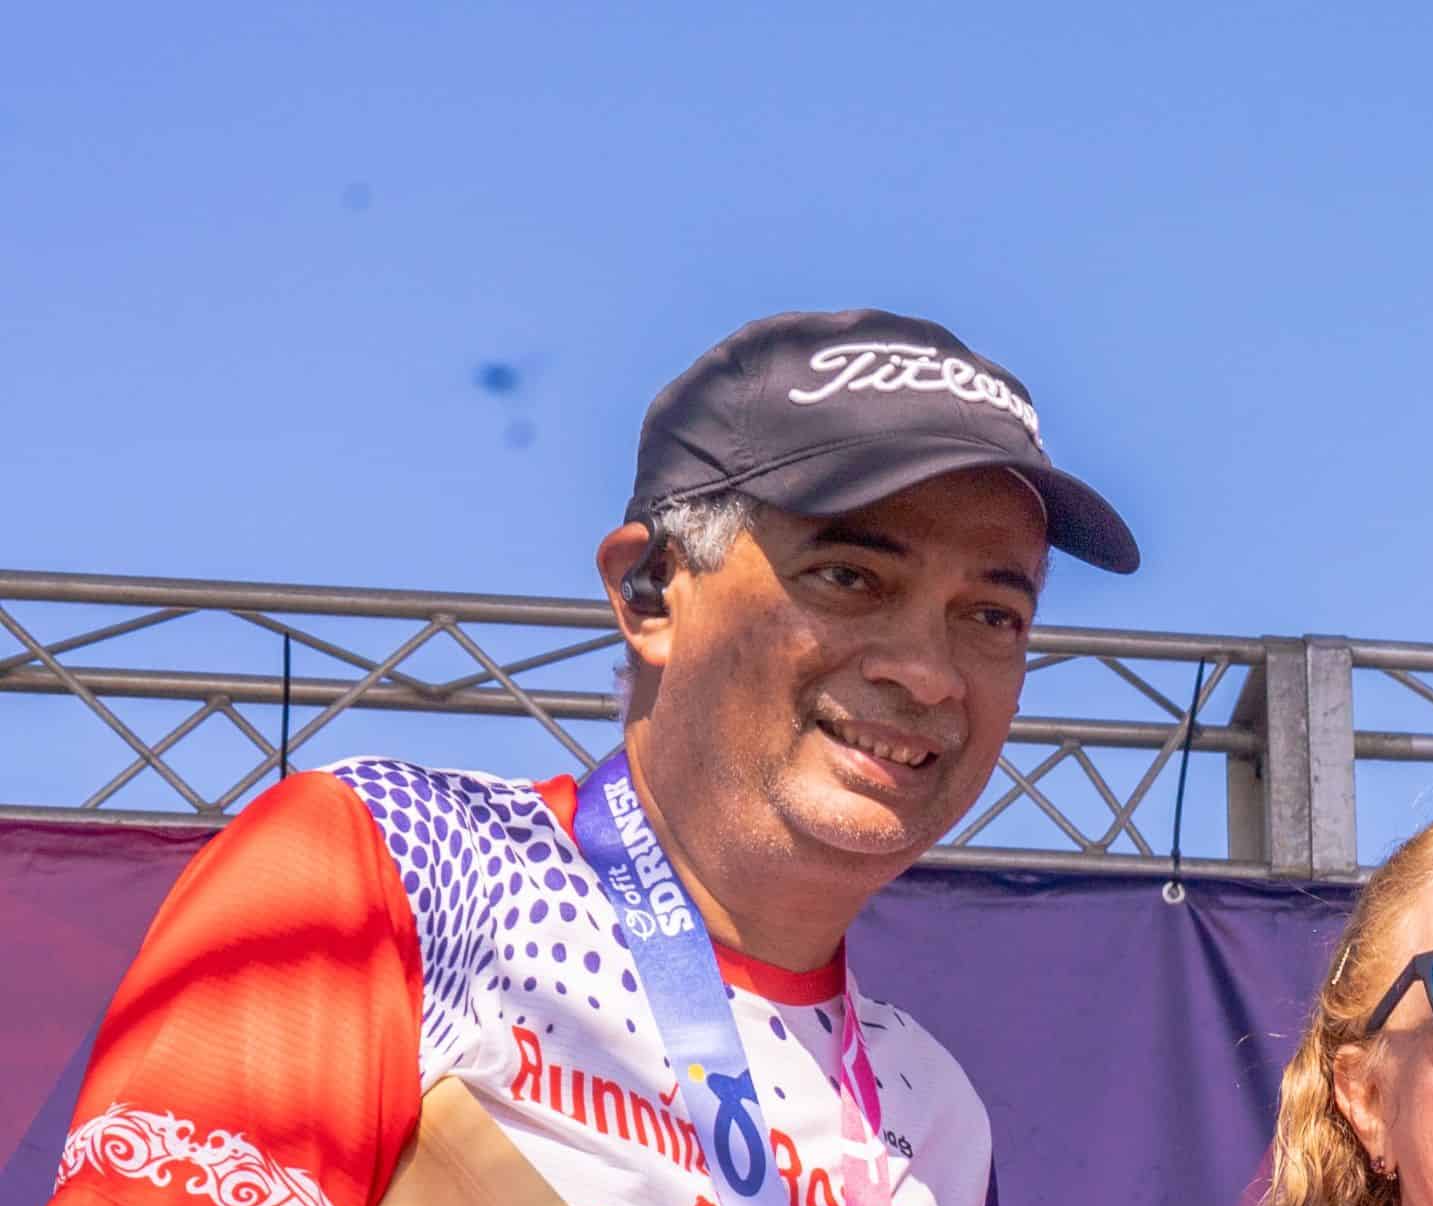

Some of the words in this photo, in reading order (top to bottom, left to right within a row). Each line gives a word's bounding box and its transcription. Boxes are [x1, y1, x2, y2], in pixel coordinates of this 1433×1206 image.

[603, 777, 695, 936] SDRUN5K
[608, 863, 643, 905] ofit
[509, 1025, 711, 1177] Runnin
